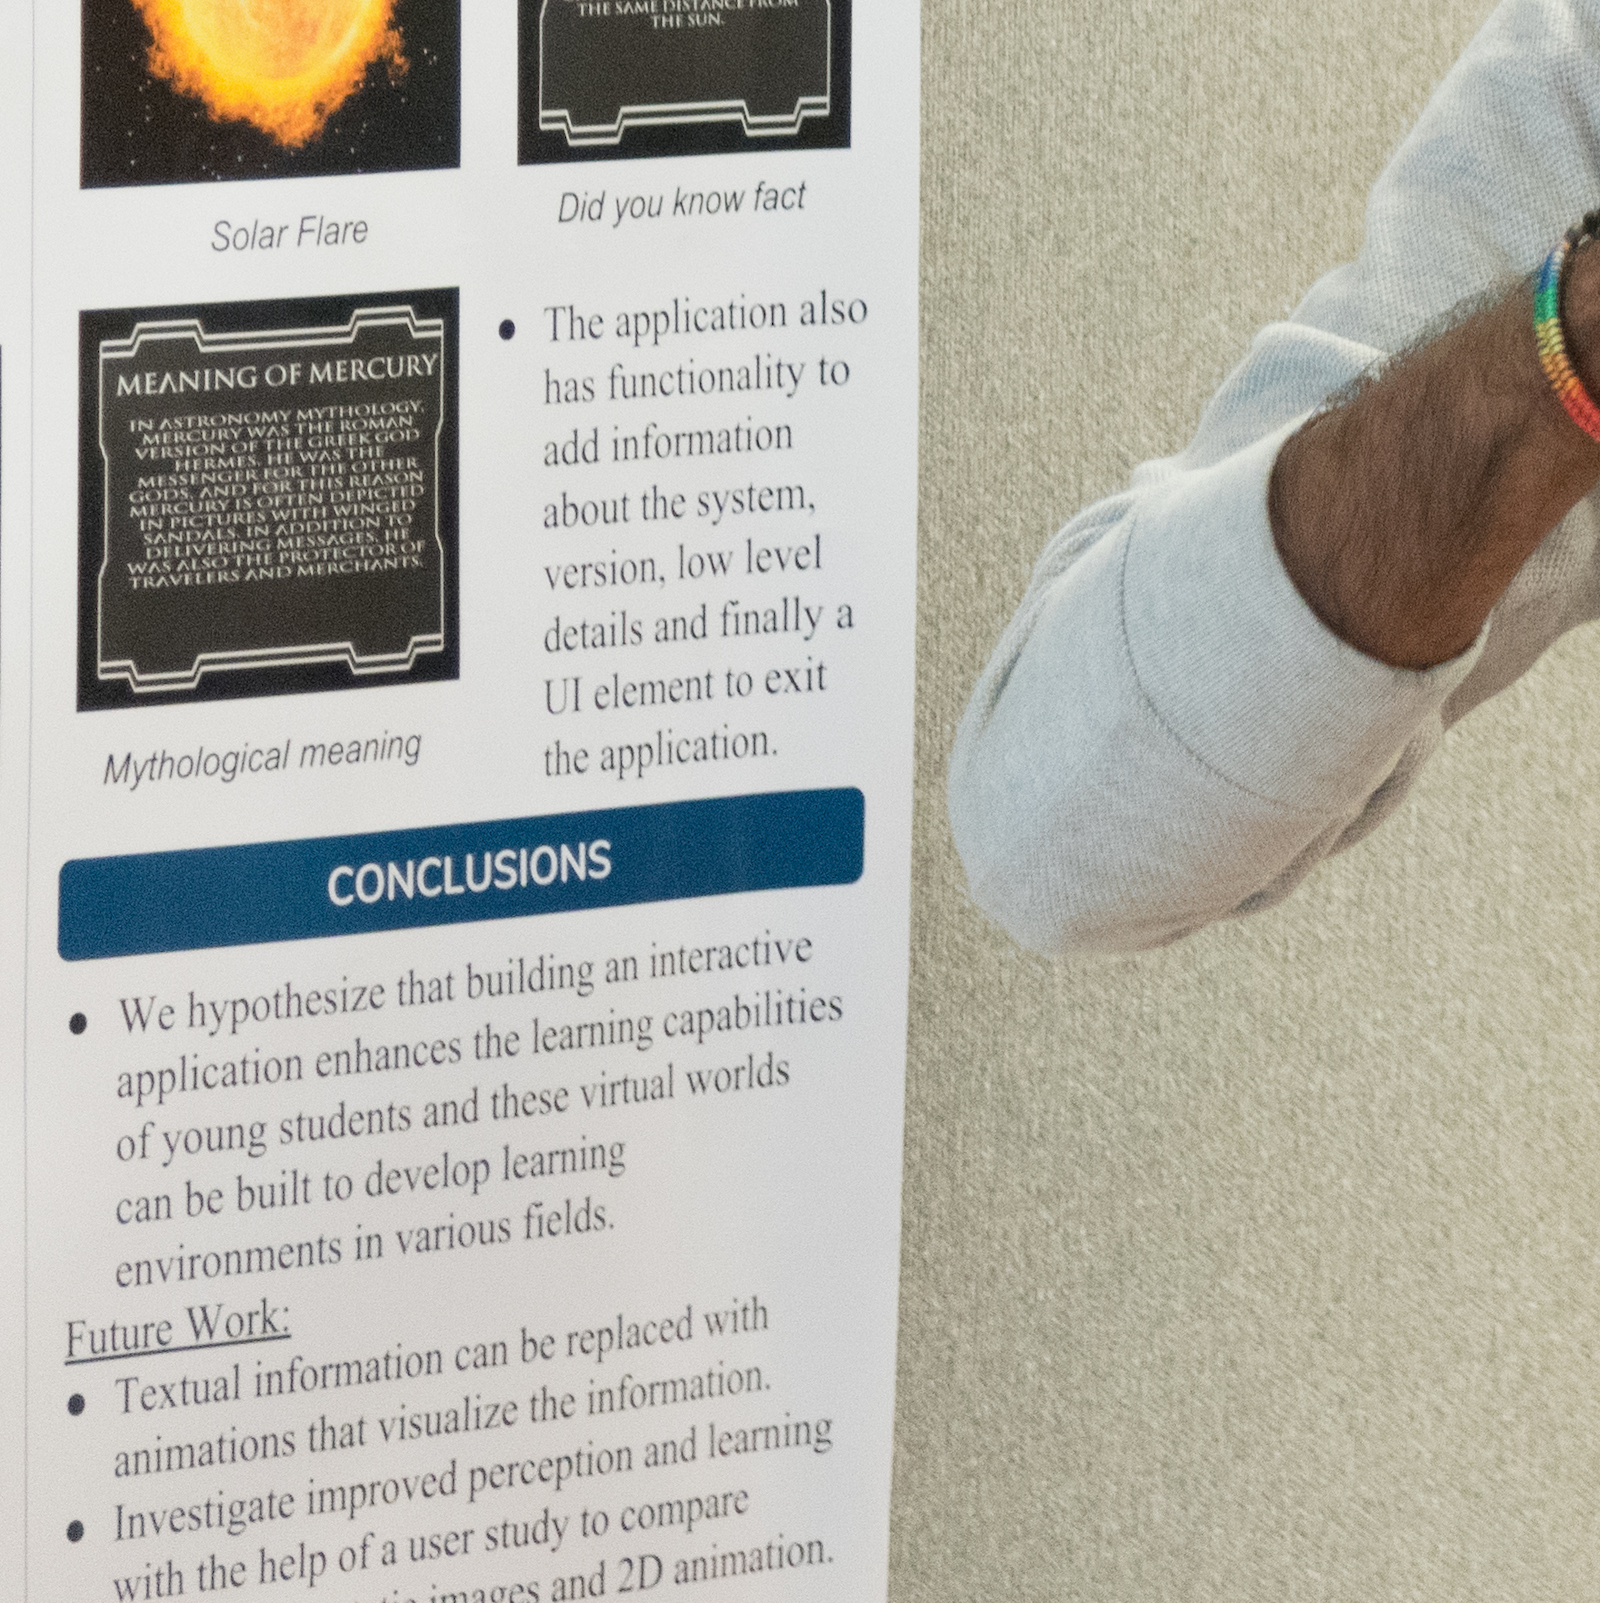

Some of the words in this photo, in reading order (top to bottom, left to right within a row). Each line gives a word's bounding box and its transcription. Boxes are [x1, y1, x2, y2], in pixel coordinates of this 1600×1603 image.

[210, 218, 290, 253] Solar
[296, 214, 369, 248] Flare
[557, 189, 606, 225] Did
[612, 194, 664, 230] you
[672, 185, 746, 217] know
[753, 179, 807, 213] fact
[544, 303, 605, 343] The
[615, 296, 787, 349] application
[799, 288, 869, 327] also
[116, 365, 257, 398] MEANING
[264, 362, 301, 387] OF
[310, 353, 438, 382] MERCURY
[544, 367, 596, 406] has
[609, 353, 805, 402] functionality
[818, 356, 851, 387] to
[543, 426, 600, 468] add
[612, 421, 793, 463] information
[543, 490, 629, 530] about
[641, 483, 687, 522] the
[697, 483, 816, 528] system,
[544, 548, 666, 591] version,
[678, 543, 733, 581] low
[746, 532, 822, 575] level
[543, 609, 643, 655] details
[654, 601, 708, 644] and
[721, 595, 823, 642] finally
[836, 603, 855, 631] a
[545, 675, 581, 716] UI
[593, 670, 713, 711] element
[725, 669, 754, 699] to
[764, 654, 826, 696] exit
[103, 737, 292, 793] Mythological
[299, 733, 423, 768] meaning
[544, 739, 590, 778] the
[600, 722, 778, 782] application.
[327, 838, 612, 908] CONCLUSIONS
[119, 995, 176, 1034] We
[188, 975, 386, 1038] hypothesize
[397, 968, 454, 1008] that
[466, 953, 595, 1001] building
[604, 955, 639, 985] an
[650, 928, 813, 980] interactive
[116, 1054, 303, 1109] application
[315, 1036, 462, 1080] enhances
[473, 1022, 521, 1062] the
[532, 1015, 654, 1055] learning
[663, 986, 844, 1046] capabilities
[116, 1121, 156, 1163] of
[162, 1119, 268, 1169] young
[279, 1100, 412, 1146] students
[422, 1085, 480, 1130] and
[490, 1081, 570, 1122] these
[580, 1062, 676, 1110] virtual
[686, 1050, 791, 1095] worlds
[115, 1193, 172, 1226] can
[185, 1179, 224, 1218] be
[236, 1168, 311, 1213] built
[323, 1171, 354, 1203] to
[364, 1150, 491, 1199] develop
[502, 1141, 626, 1182] learning
[115, 1235, 342, 1290] environments
[355, 1223, 383, 1262] in
[395, 1212, 512, 1255] various
[524, 1195, 614, 1241] fields.
[67, 1319, 173, 1359] Future
[186, 1296, 289, 1342] Work:
[115, 1362, 241, 1415] Textual
[255, 1342, 443, 1399] information
[454, 1339, 508, 1373] can
[520, 1325, 556, 1364] be
[566, 1304, 693, 1365] replaced
[703, 1294, 769, 1336] with
[114, 1425, 296, 1479] animations
[307, 1413, 366, 1454] that
[378, 1393, 519, 1443] visualize
[529, 1384, 576, 1425] the
[587, 1366, 771, 1416] information.
[115, 1489, 295, 1542] Investigate
[307, 1457, 457, 1522] improved
[468, 1445, 633, 1504] perception
[643, 1424, 697, 1470] and
[709, 1418, 833, 1459] learning
[113, 1559, 184, 1602] with
[196, 1552, 247, 1593] the
[259, 1541, 327, 1589] help
[338, 1531, 377, 1573] of
[381, 1540, 398, 1568] a
[409, 1528, 475, 1564] user
[485, 1506, 566, 1554] study
[580, 1508, 610, 1539] to
[620, 1489, 749, 1534] compare
[550, 1558, 606, 1603] and
[617, 1553, 664, 1595] 2D
[673, 1538, 834, 1587] animation.
